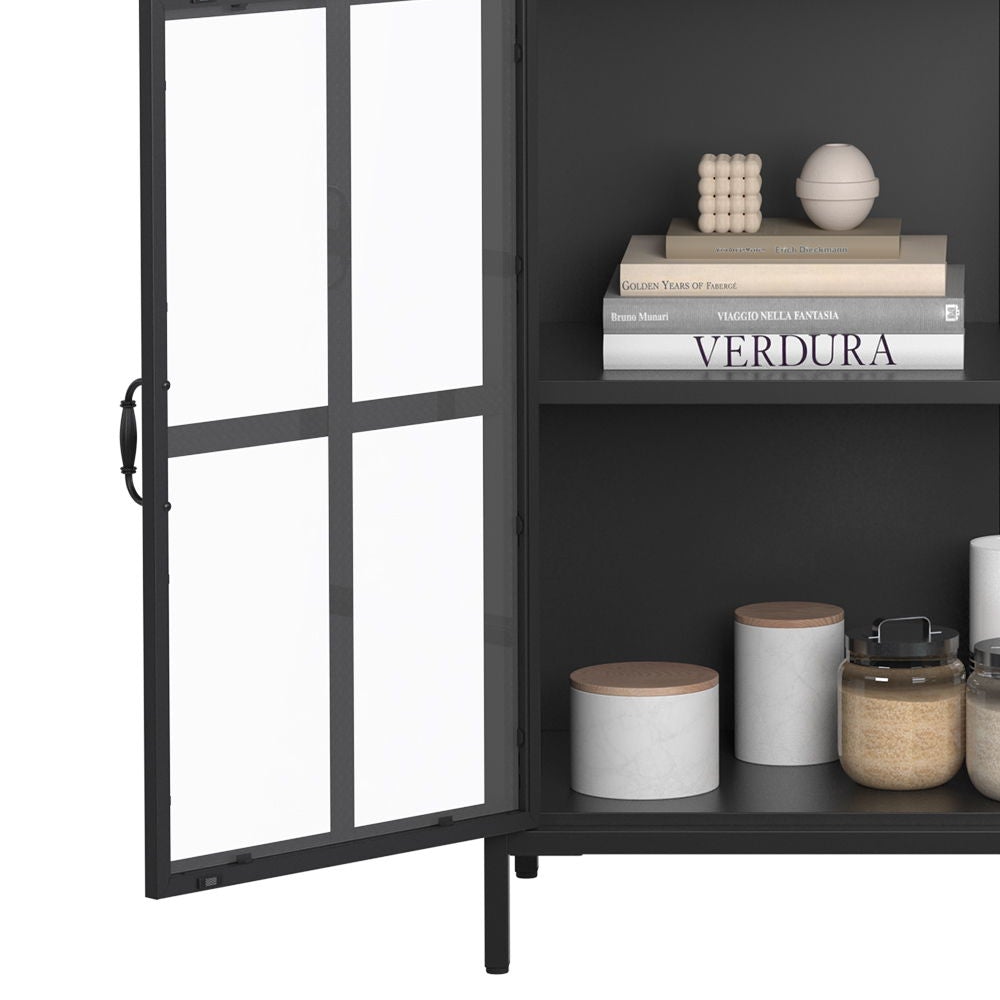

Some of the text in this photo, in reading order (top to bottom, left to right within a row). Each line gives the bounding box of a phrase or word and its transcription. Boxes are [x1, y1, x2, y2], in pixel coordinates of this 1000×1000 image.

[621, 280, 659, 291] GOLDEN
[661, 280, 690, 291] YEARS
[691, 281, 703, 290] OF
[610, 311, 669, 322] Bruno Munari
[717, 310, 839, 321] VIAGGIO NELLA FANTASIA
[692, 333, 897, 368] VERDURA
